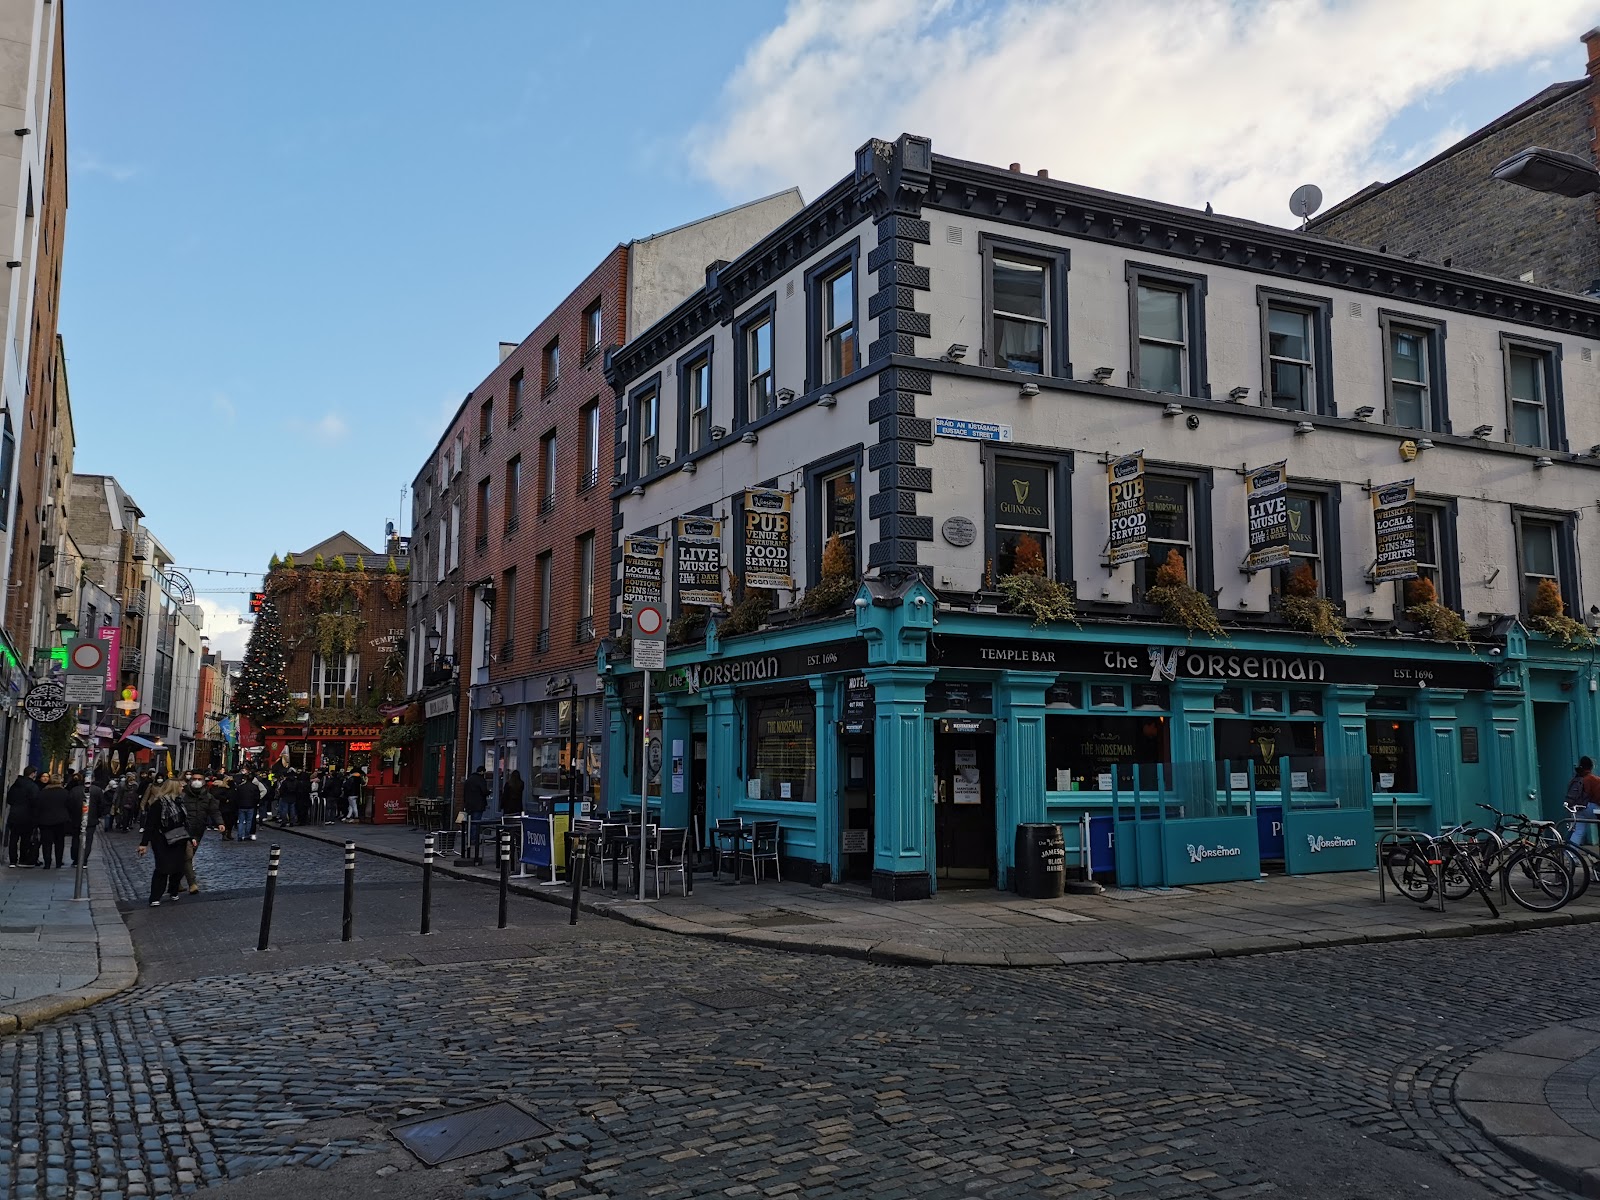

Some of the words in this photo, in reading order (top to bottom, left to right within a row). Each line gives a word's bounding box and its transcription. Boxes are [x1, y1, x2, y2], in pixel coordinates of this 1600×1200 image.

[936, 419, 954, 427] SRÁID
[942, 427, 967, 436] EUSTACE
[972, 430, 994, 438] STREET
[1003, 429, 1008, 438] 2
[1110, 478, 1145, 503] PUB
[1000, 501, 1042, 515] GUINNESS
[1111, 498, 1138, 512] VENUE
[1250, 496, 1286, 519] LIVE
[1111, 505, 1146, 519] RESTAURANT
[1375, 506, 1414, 520] WHISKEYS
[746, 512, 788, 532] PUB
[1111, 512, 1146, 532] FOOD
[1250, 511, 1287, 530] MUSIC
[1377, 517, 1405, 529] LOCAL
[1406, 515, 1414, 523] &
[746, 530, 778, 540] VENUE
[780, 533, 788, 541] &
[1111, 525, 1146, 540] SERVED
[1251, 530, 1265, 539] TILL
[1270, 525, 1287, 534] DAYS
[746, 538, 788, 547] RESTAURANT
[1251, 537, 1265, 545] LATE
[1288, 533, 1312, 542] INNESS
[1378, 531, 1414, 544] BOUTIQUE
[746, 545, 787, 559] FOOD
[1378, 541, 1400, 553] GINS
[679, 547, 718, 561] LIVE
[1378, 548, 1415, 562] SPIRITS!
[625, 558, 662, 567] WHISKEYS
[679, 561, 718, 571] MUSIC
[745, 557, 788, 567] SERVED
[625, 566, 653, 575] LOCAL
[625, 579, 661, 587] BOUTIQUE
[625, 586, 647, 594] GINS
[624, 593, 661, 602] SPIRITS!
[389, 628, 404, 636] THE
[807, 655, 821, 666] EST.
[822, 652, 838, 664] 1696
[980, 648, 1029, 661] TEMPLE
[1031, 650, 1056, 662] BAR
[1103, 651, 1139, 669] The
[668, 673, 682, 687] The
[1393, 668, 1412, 679] EST.
[1414, 669, 1434, 680] 1696
[313, 728, 339, 736] THE
[343, 728, 381, 736] TEMPL
[777, 720, 803, 734] NORSEMAN
[1080, 741, 1094, 756] THE
[1094, 743, 1134, 756] NORSEMAN
[527, 830, 547, 846] PERONI
[1040, 848, 1065, 858] JAMESON
